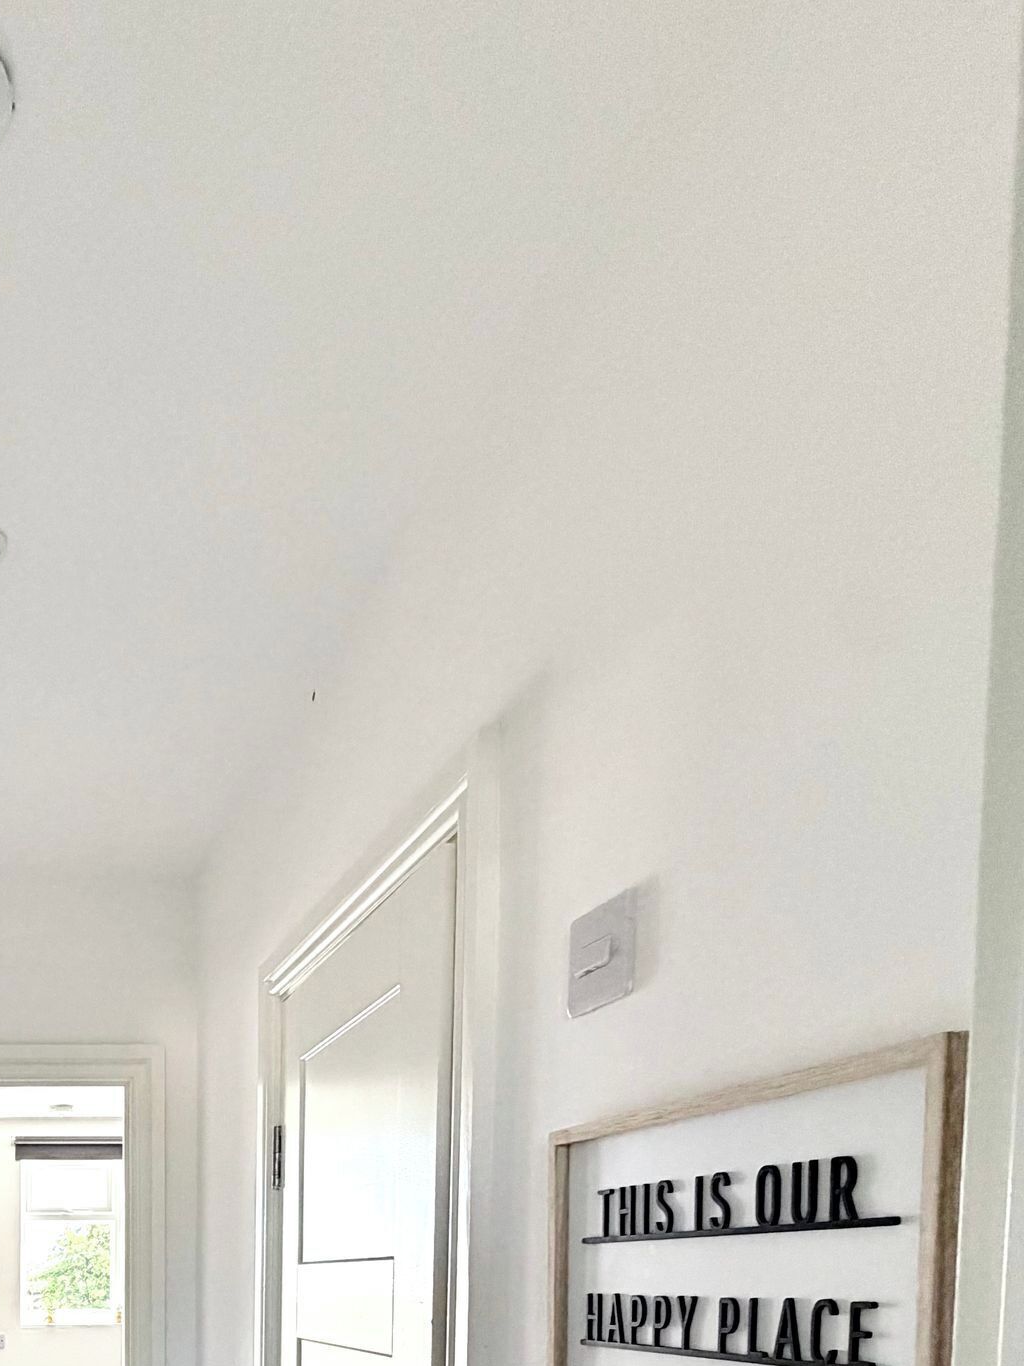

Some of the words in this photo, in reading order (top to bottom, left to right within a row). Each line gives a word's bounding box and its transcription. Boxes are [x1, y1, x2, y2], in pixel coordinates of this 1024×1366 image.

[598, 1180, 675, 1236] THIS
[695, 1171, 733, 1230] IS
[755, 1156, 861, 1226] OUR
[586, 1292, 699, 1349] HAPPY
